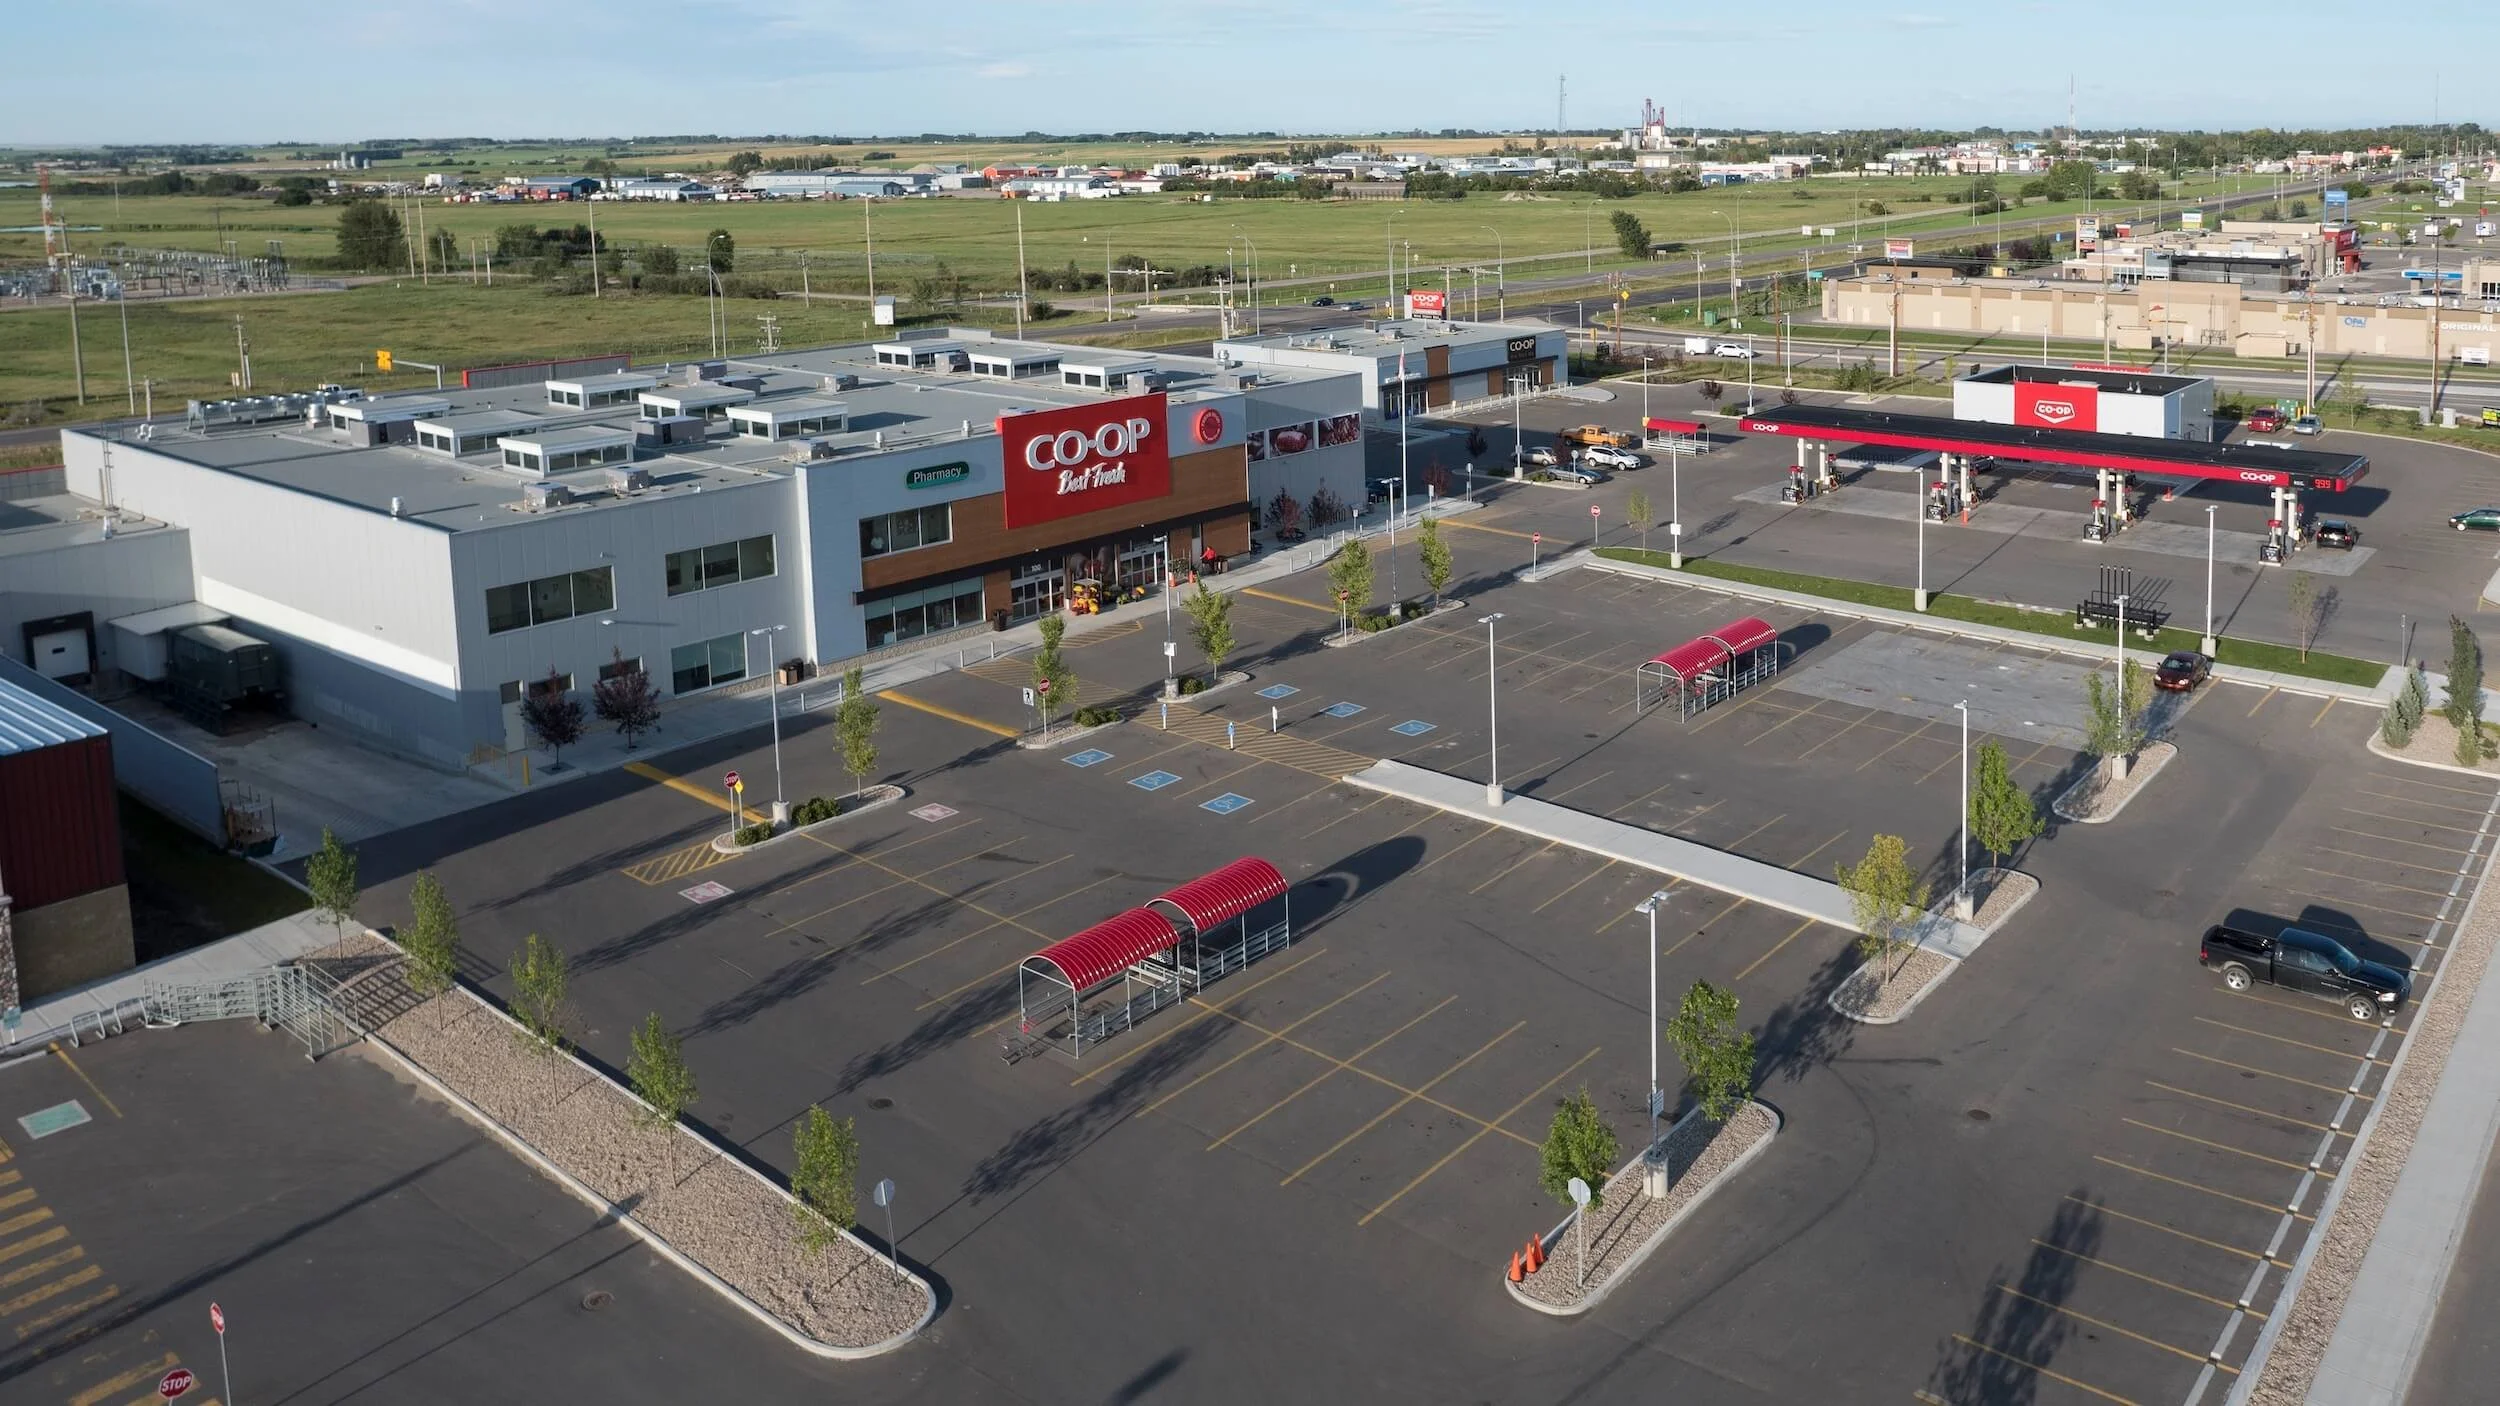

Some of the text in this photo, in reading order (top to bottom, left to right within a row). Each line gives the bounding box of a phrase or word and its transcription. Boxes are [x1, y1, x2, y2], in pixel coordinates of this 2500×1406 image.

[2440, 322, 2497, 332] ORIGINAL
[913, 466, 962, 483] Pharmacy
[1057, 461, 1126, 495] Best Fresh
[161, 1375, 192, 1392] STOP
